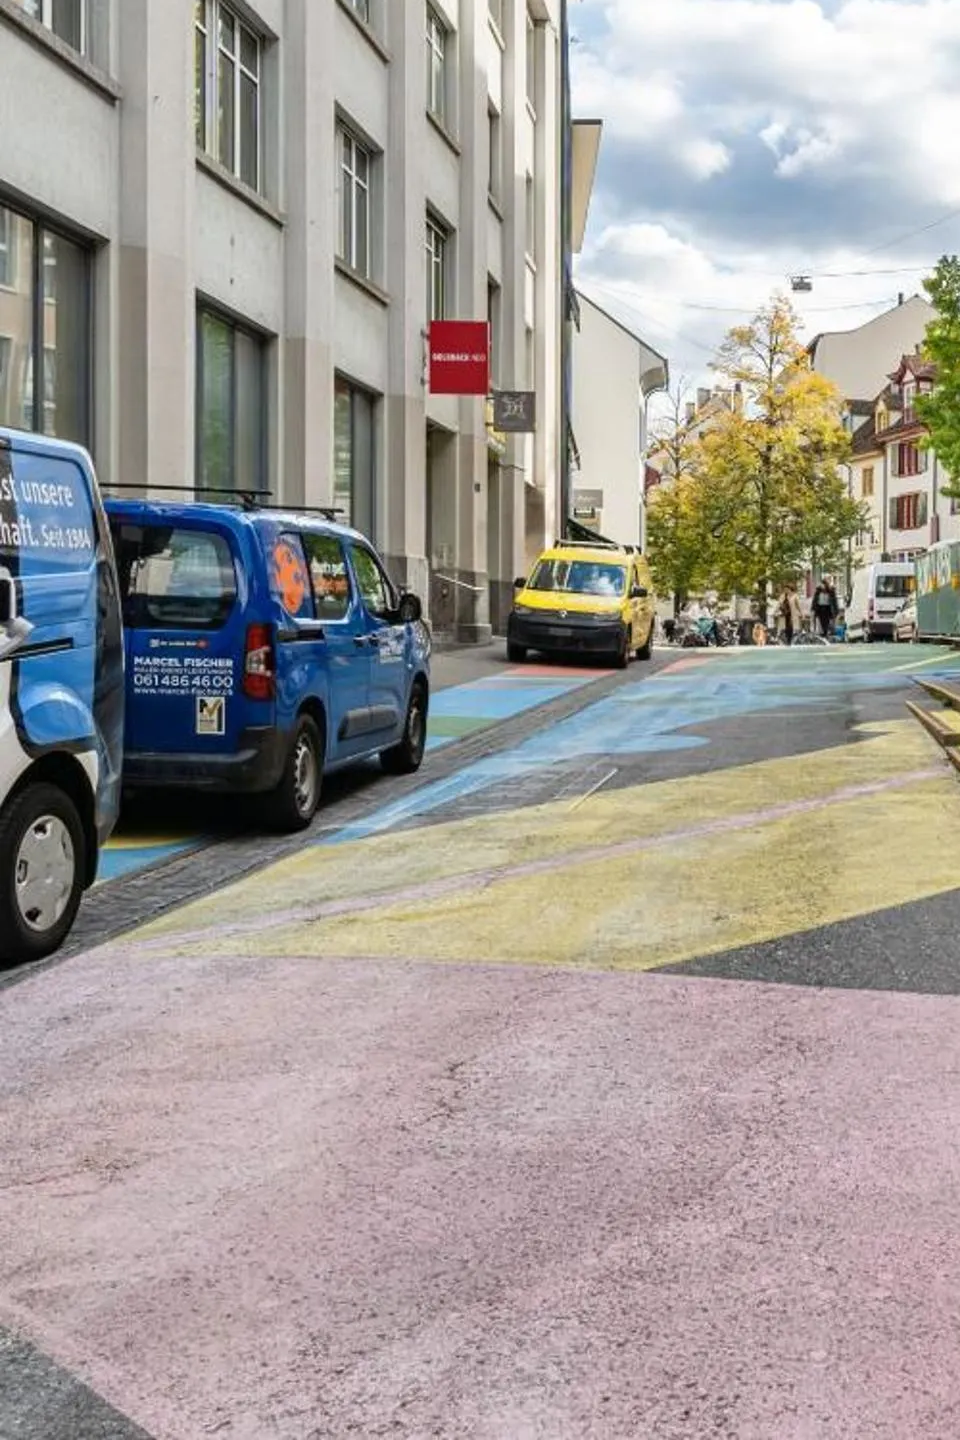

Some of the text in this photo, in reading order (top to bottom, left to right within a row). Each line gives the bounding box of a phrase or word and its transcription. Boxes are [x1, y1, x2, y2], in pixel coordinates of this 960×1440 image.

[0, 474, 73, 507] st unsere
[41, 524, 65, 548] Seit
[66, 527, 91, 548] 1984
[134, 656, 233, 668] MARCEL FISCHER
